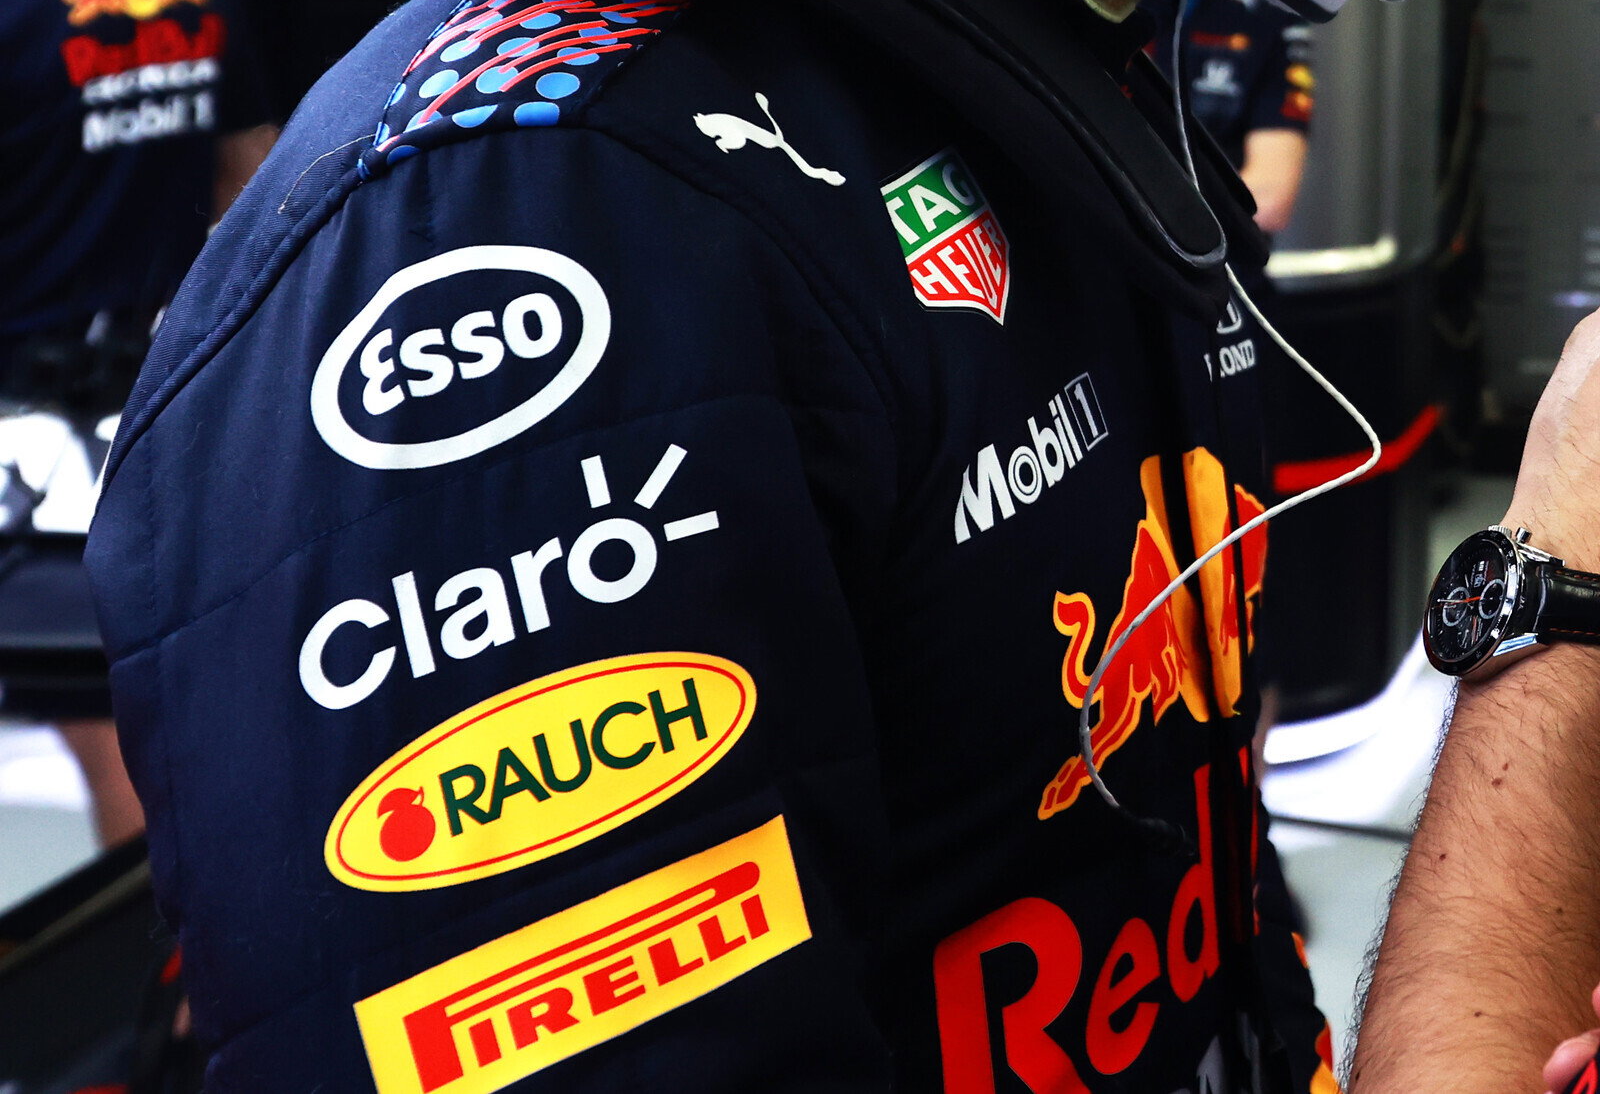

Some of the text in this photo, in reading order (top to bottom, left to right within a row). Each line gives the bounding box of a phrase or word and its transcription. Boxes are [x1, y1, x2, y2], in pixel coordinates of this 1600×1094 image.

[885, 162, 976, 246] TAG
[909, 218, 1003, 310] HEUER
[438, 677, 708, 837] RAUCH
[402, 860, 771, 1094] PIRELLI
